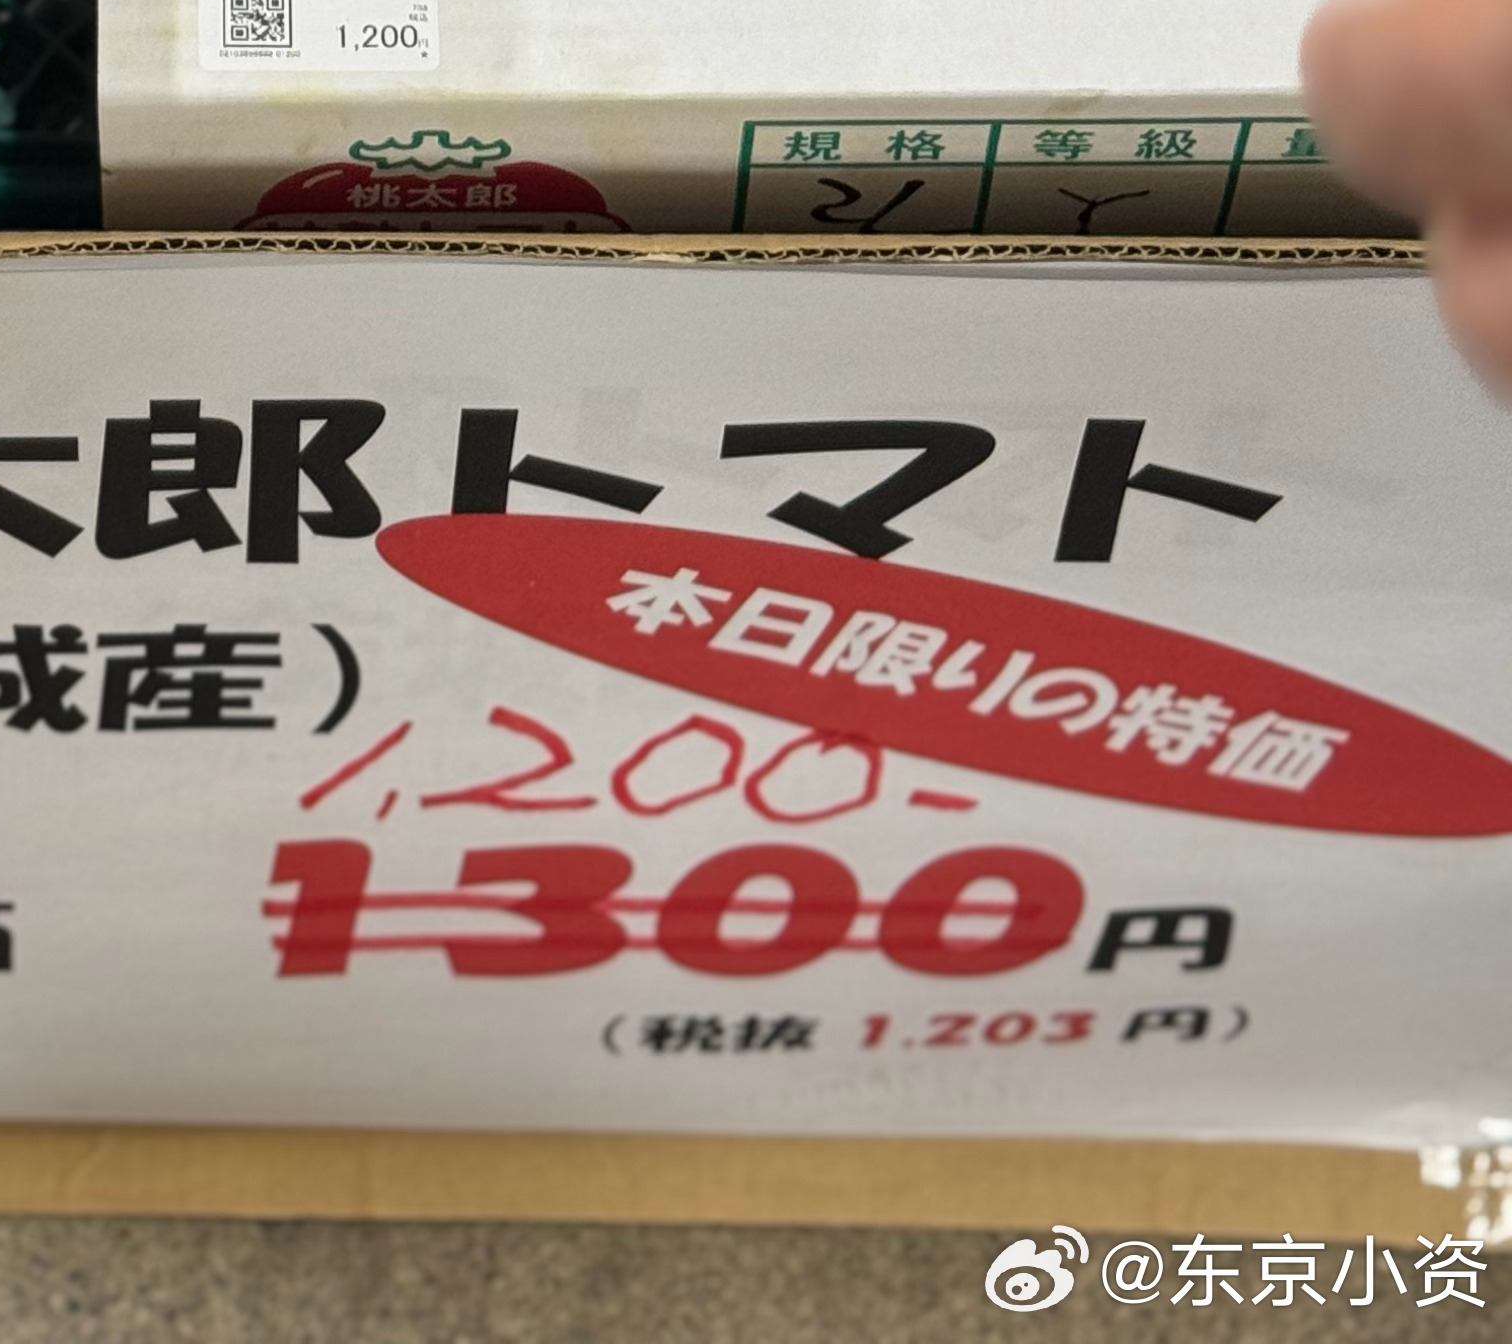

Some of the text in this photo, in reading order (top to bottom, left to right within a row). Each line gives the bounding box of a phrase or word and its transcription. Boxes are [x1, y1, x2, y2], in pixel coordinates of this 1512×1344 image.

[783, 128, 1197, 161] 規格 等級
[347, 182, 518, 209] 桃太郎
[605, 566, 1350, 793] 本日限りの特価
